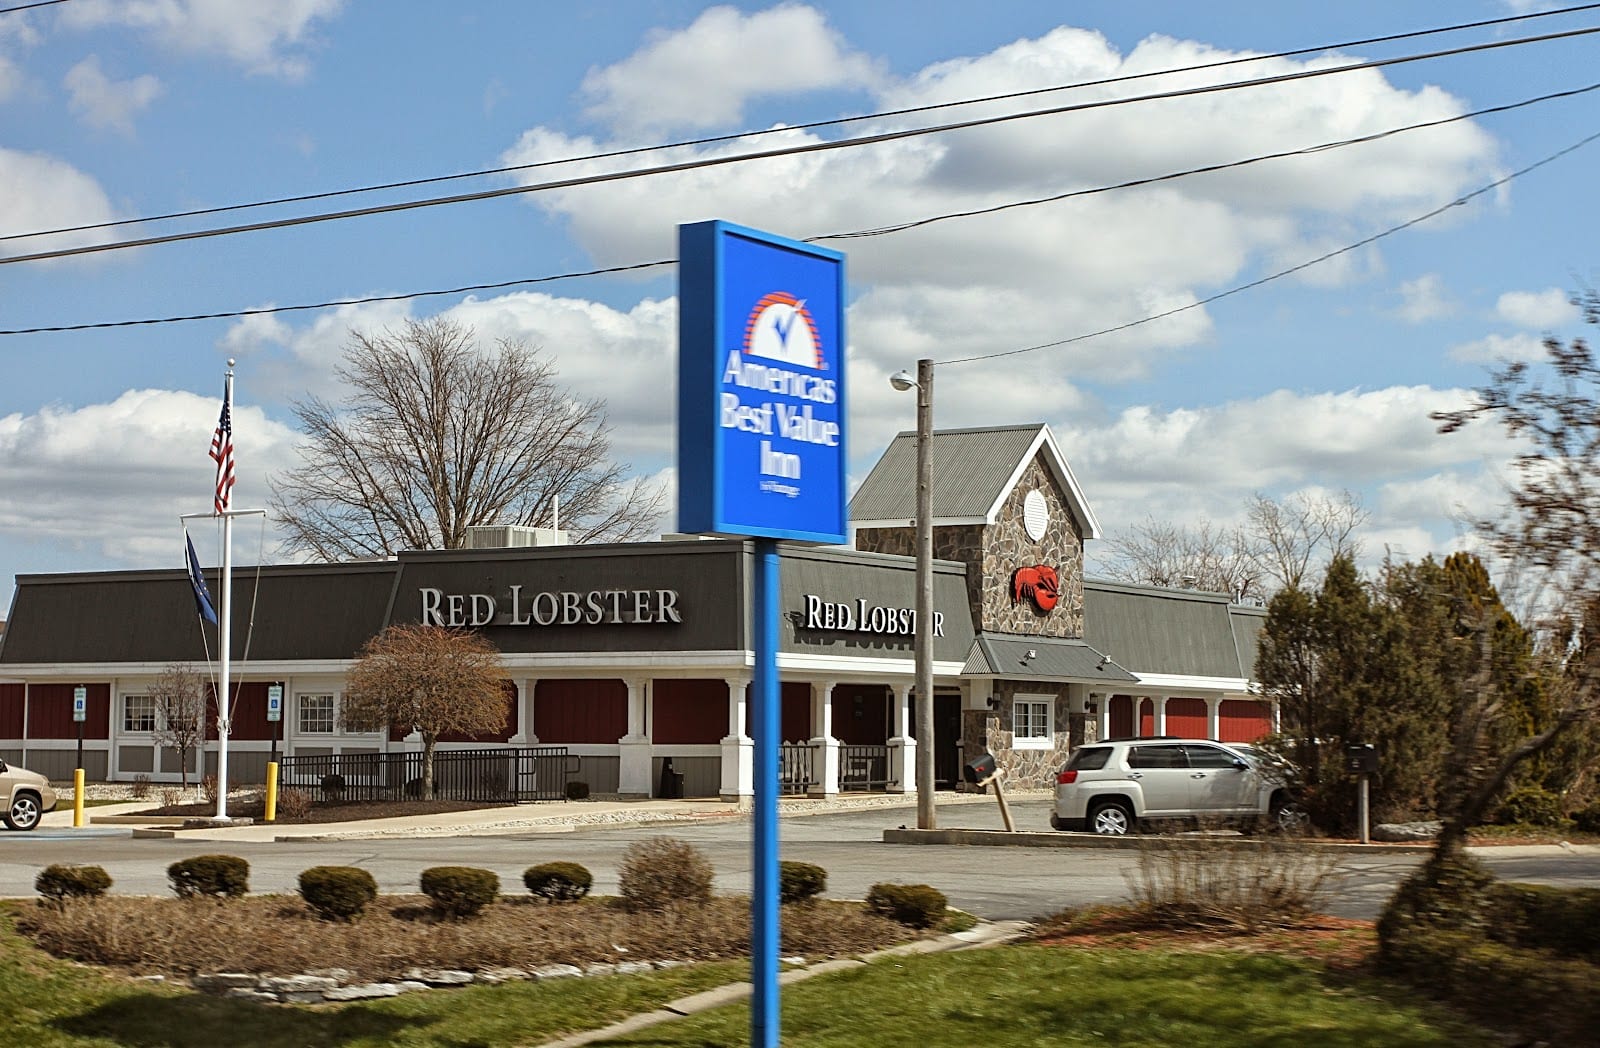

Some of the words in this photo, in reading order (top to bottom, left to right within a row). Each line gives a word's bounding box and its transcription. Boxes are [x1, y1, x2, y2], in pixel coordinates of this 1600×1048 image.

[723, 349, 836, 404] Americas
[719, 392, 774, 436] Best
[773, 402, 840, 446] Value
[760, 440, 801, 479] Inn
[419, 587, 496, 627] RED
[509, 585, 681, 626] LOBSTER
[807, 594, 852, 630] RED
[859, 599, 945, 637] LOBSTR
